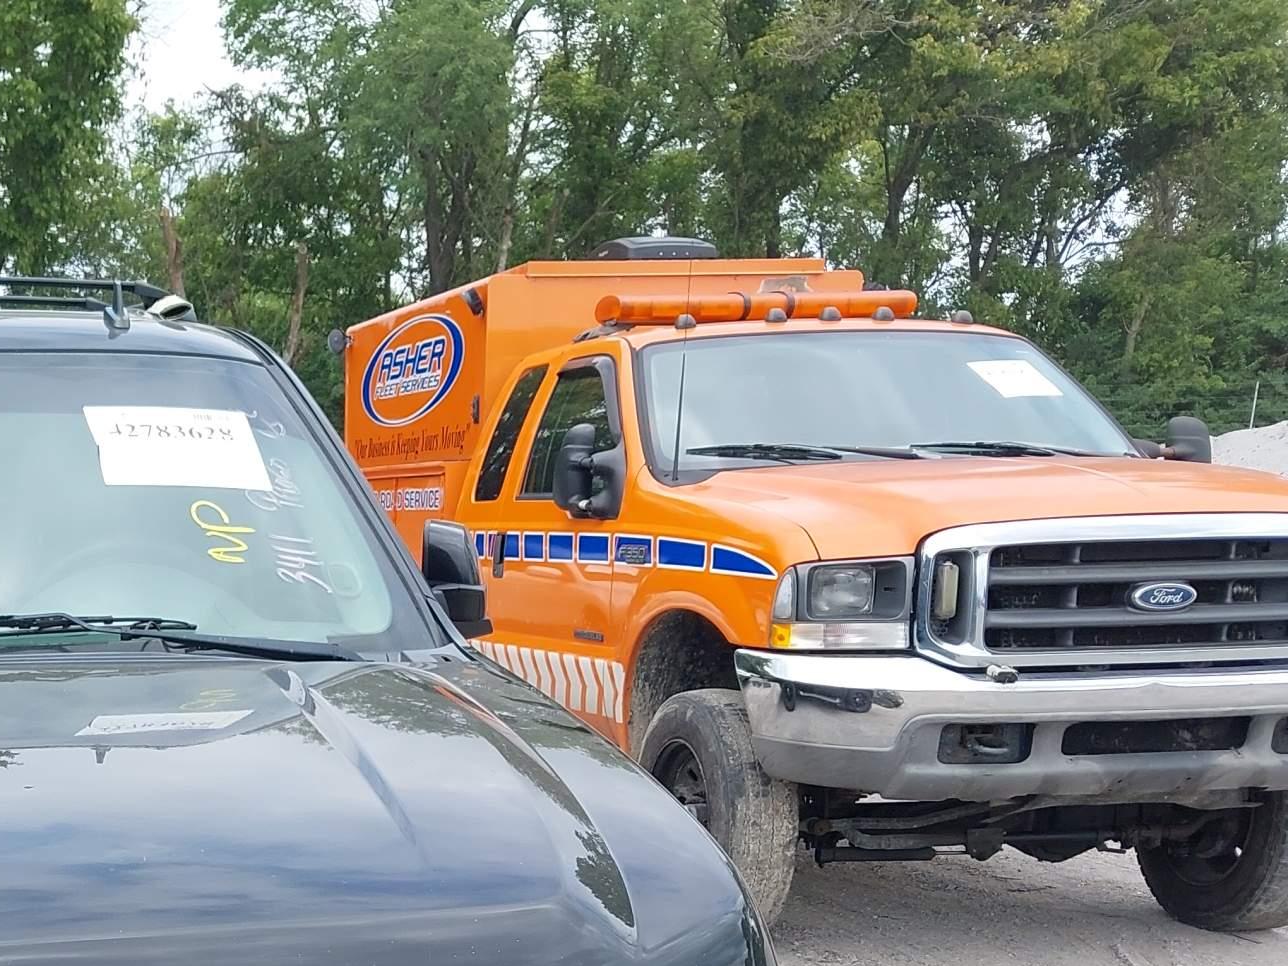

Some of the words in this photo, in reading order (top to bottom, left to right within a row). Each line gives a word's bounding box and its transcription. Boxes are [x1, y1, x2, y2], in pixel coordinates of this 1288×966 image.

[378, 337, 446, 383] ASHER
[375, 382, 400, 398] FLEET
[399, 374, 441, 394] SERVICES
[368, 437, 391, 458] Business
[391, 434, 397, 456] is
[396, 432, 420, 460] Keeping
[404, 489, 440, 508] SERVICE
[190, 500, 256, 563] NP
[1150, 588, 1184, 604] Ford
